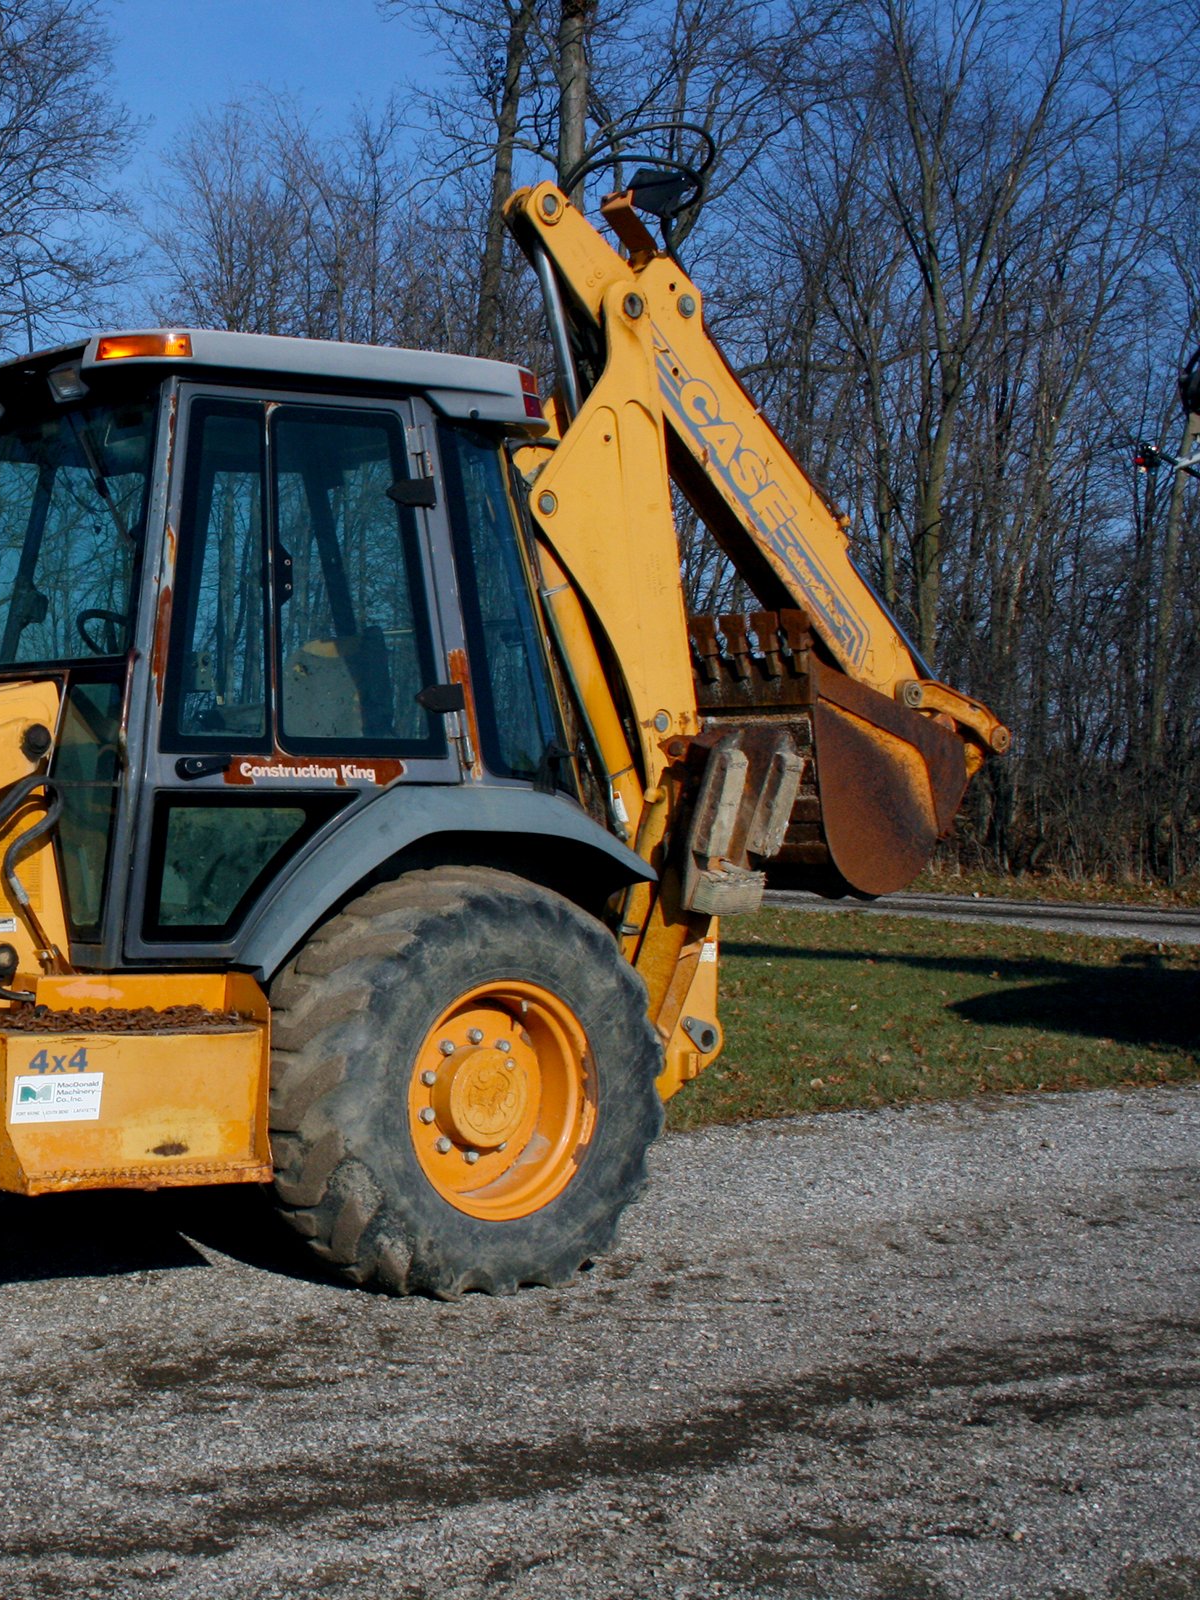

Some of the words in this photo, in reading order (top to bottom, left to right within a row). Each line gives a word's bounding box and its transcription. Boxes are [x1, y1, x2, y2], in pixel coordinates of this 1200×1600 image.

[679, 379, 796, 531] CASE
[240, 762, 338, 778] Construction
[341, 764, 376, 782] King
[28, 1047, 88, 1074] 4x4
